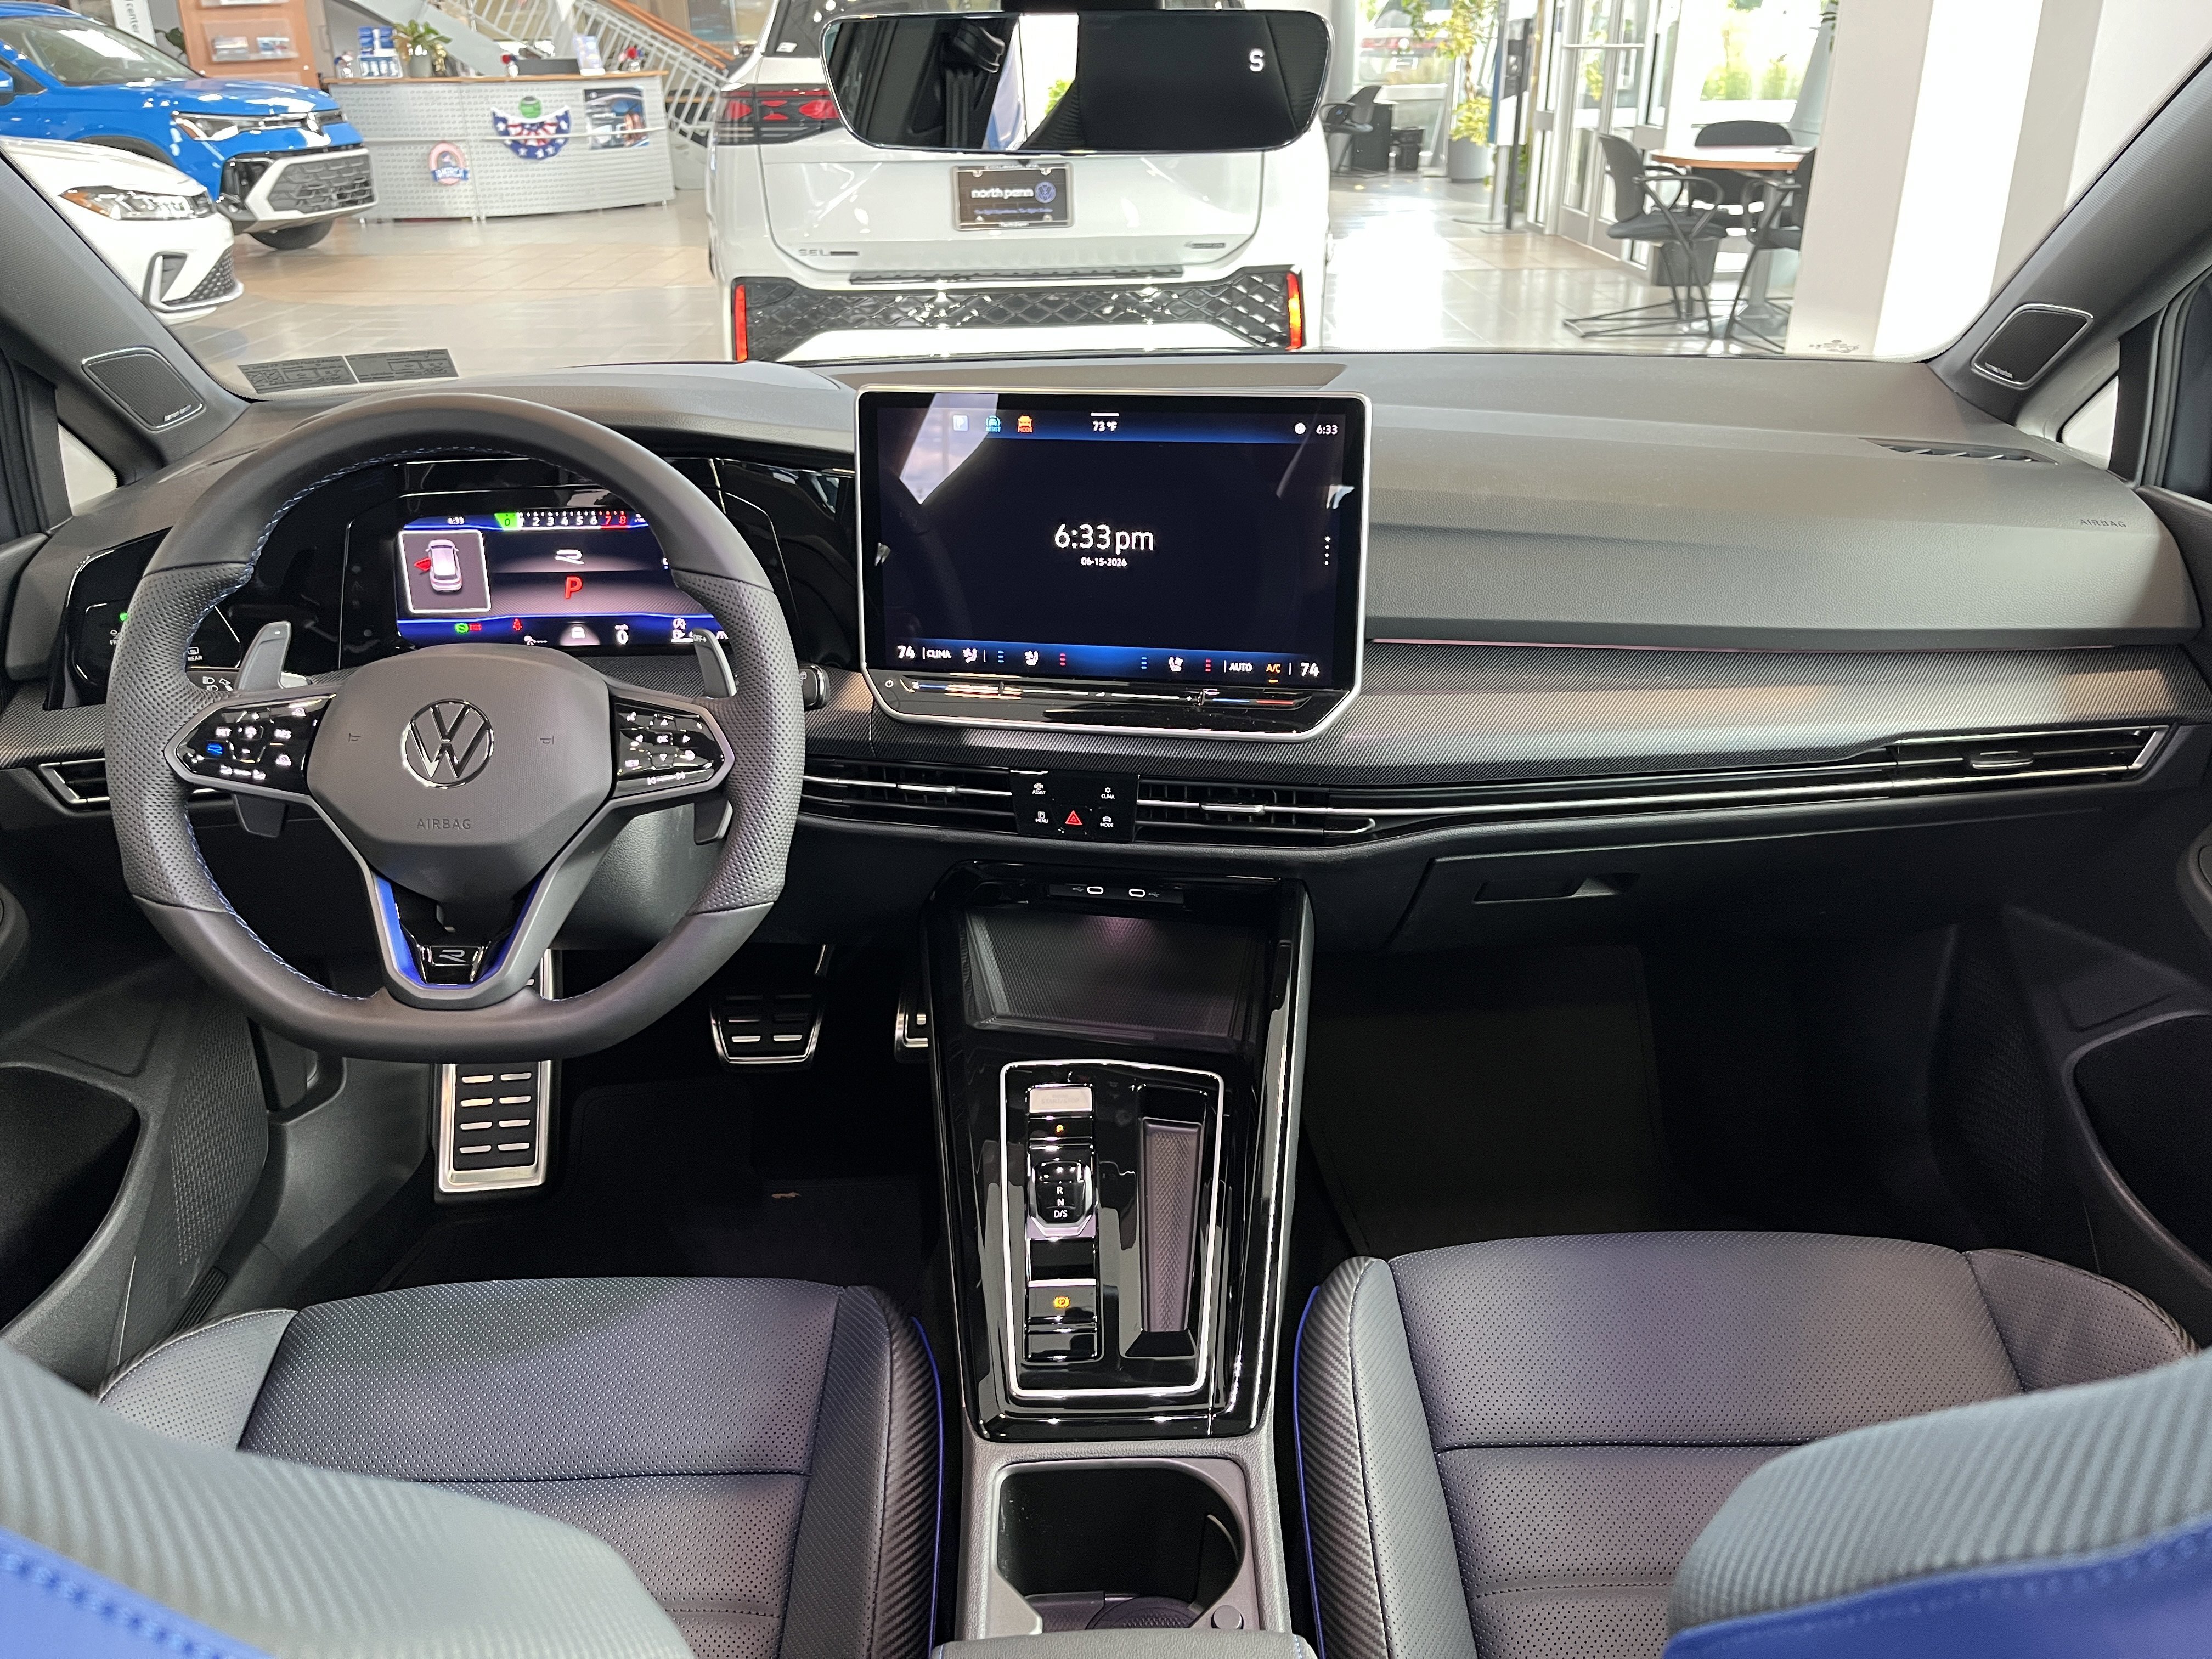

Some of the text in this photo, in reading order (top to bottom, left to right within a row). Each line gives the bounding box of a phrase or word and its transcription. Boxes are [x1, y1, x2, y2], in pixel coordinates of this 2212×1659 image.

[1249, 48, 1264, 72] S
[971, 187, 1003, 198] north
[1093, 421, 1117, 432] 73 °F
[1316, 425, 1338, 435] 6:33
[447, 517, 465, 525] 6:33
[532, 516, 540, 526] 2
[546, 516, 555, 526] 3
[560, 516, 569, 526] 4
[575, 515, 583, 526] 5
[589, 516, 598, 526] 6
[605, 515, 612, 525] 7
[618, 515, 627, 525] 8
[2080, 518, 2126, 527] AIRBAG
[1054, 523, 1154, 555] 6:33 pm
[1081, 556, 1127, 567] 06-15-2026
[565, 576, 583, 599] P
[617, 630, 629, 644] 0
[897, 645, 916, 659] 74
[926, 649, 951, 659] CLIMA
[1229, 662, 1320, 677] AUTO A/C 74
[416, 818, 472, 830] AIRBAG
[1056, 1125, 1064, 1133] P
[1057, 1186, 1063, 1194] R
[1057, 1198, 1064, 1206] N
[1053, 1210, 1068, 1218] D/S
